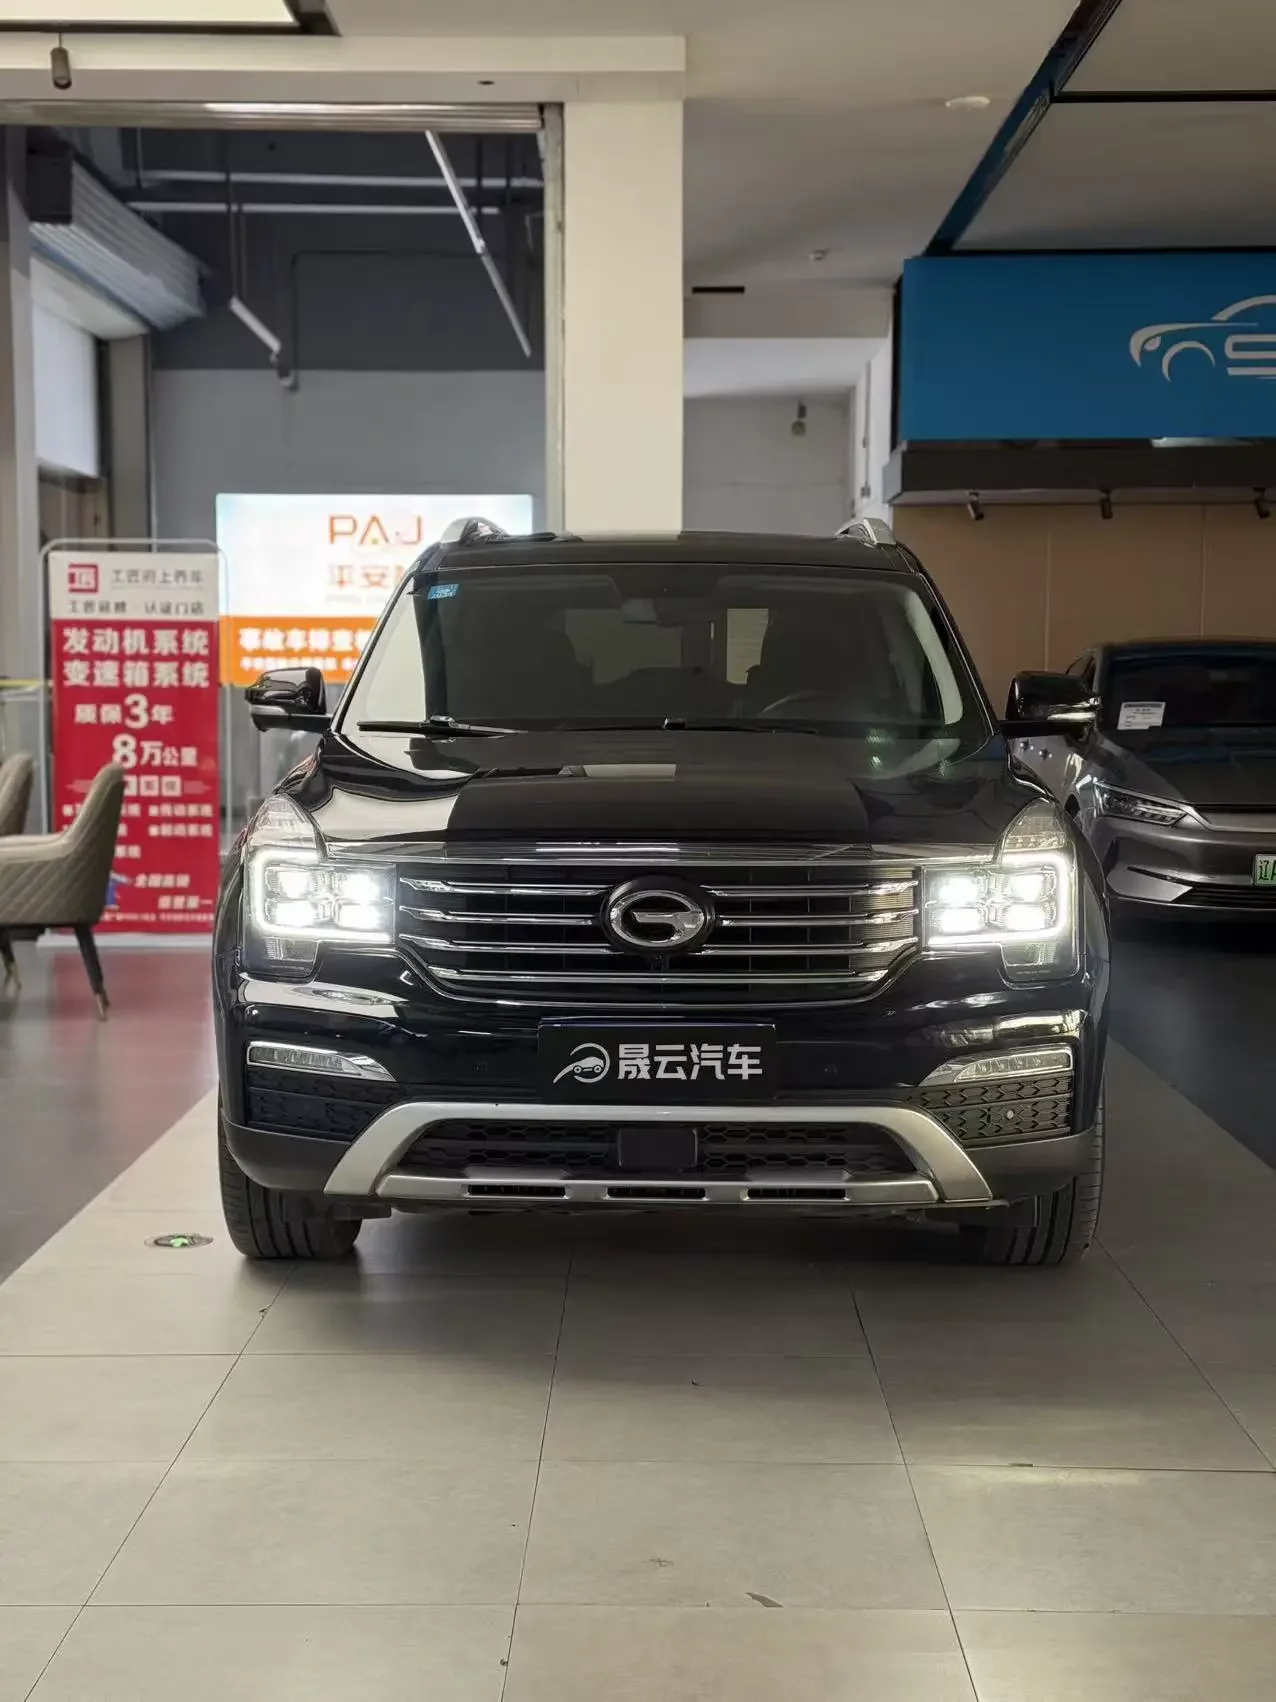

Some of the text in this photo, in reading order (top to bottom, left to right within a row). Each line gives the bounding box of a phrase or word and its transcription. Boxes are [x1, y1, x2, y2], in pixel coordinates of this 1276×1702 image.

[62, 626, 210, 656] 发动机系统
[62, 659, 210, 688] 变速箱系统
[617, 1043, 763, 1081] 晟云汽车
